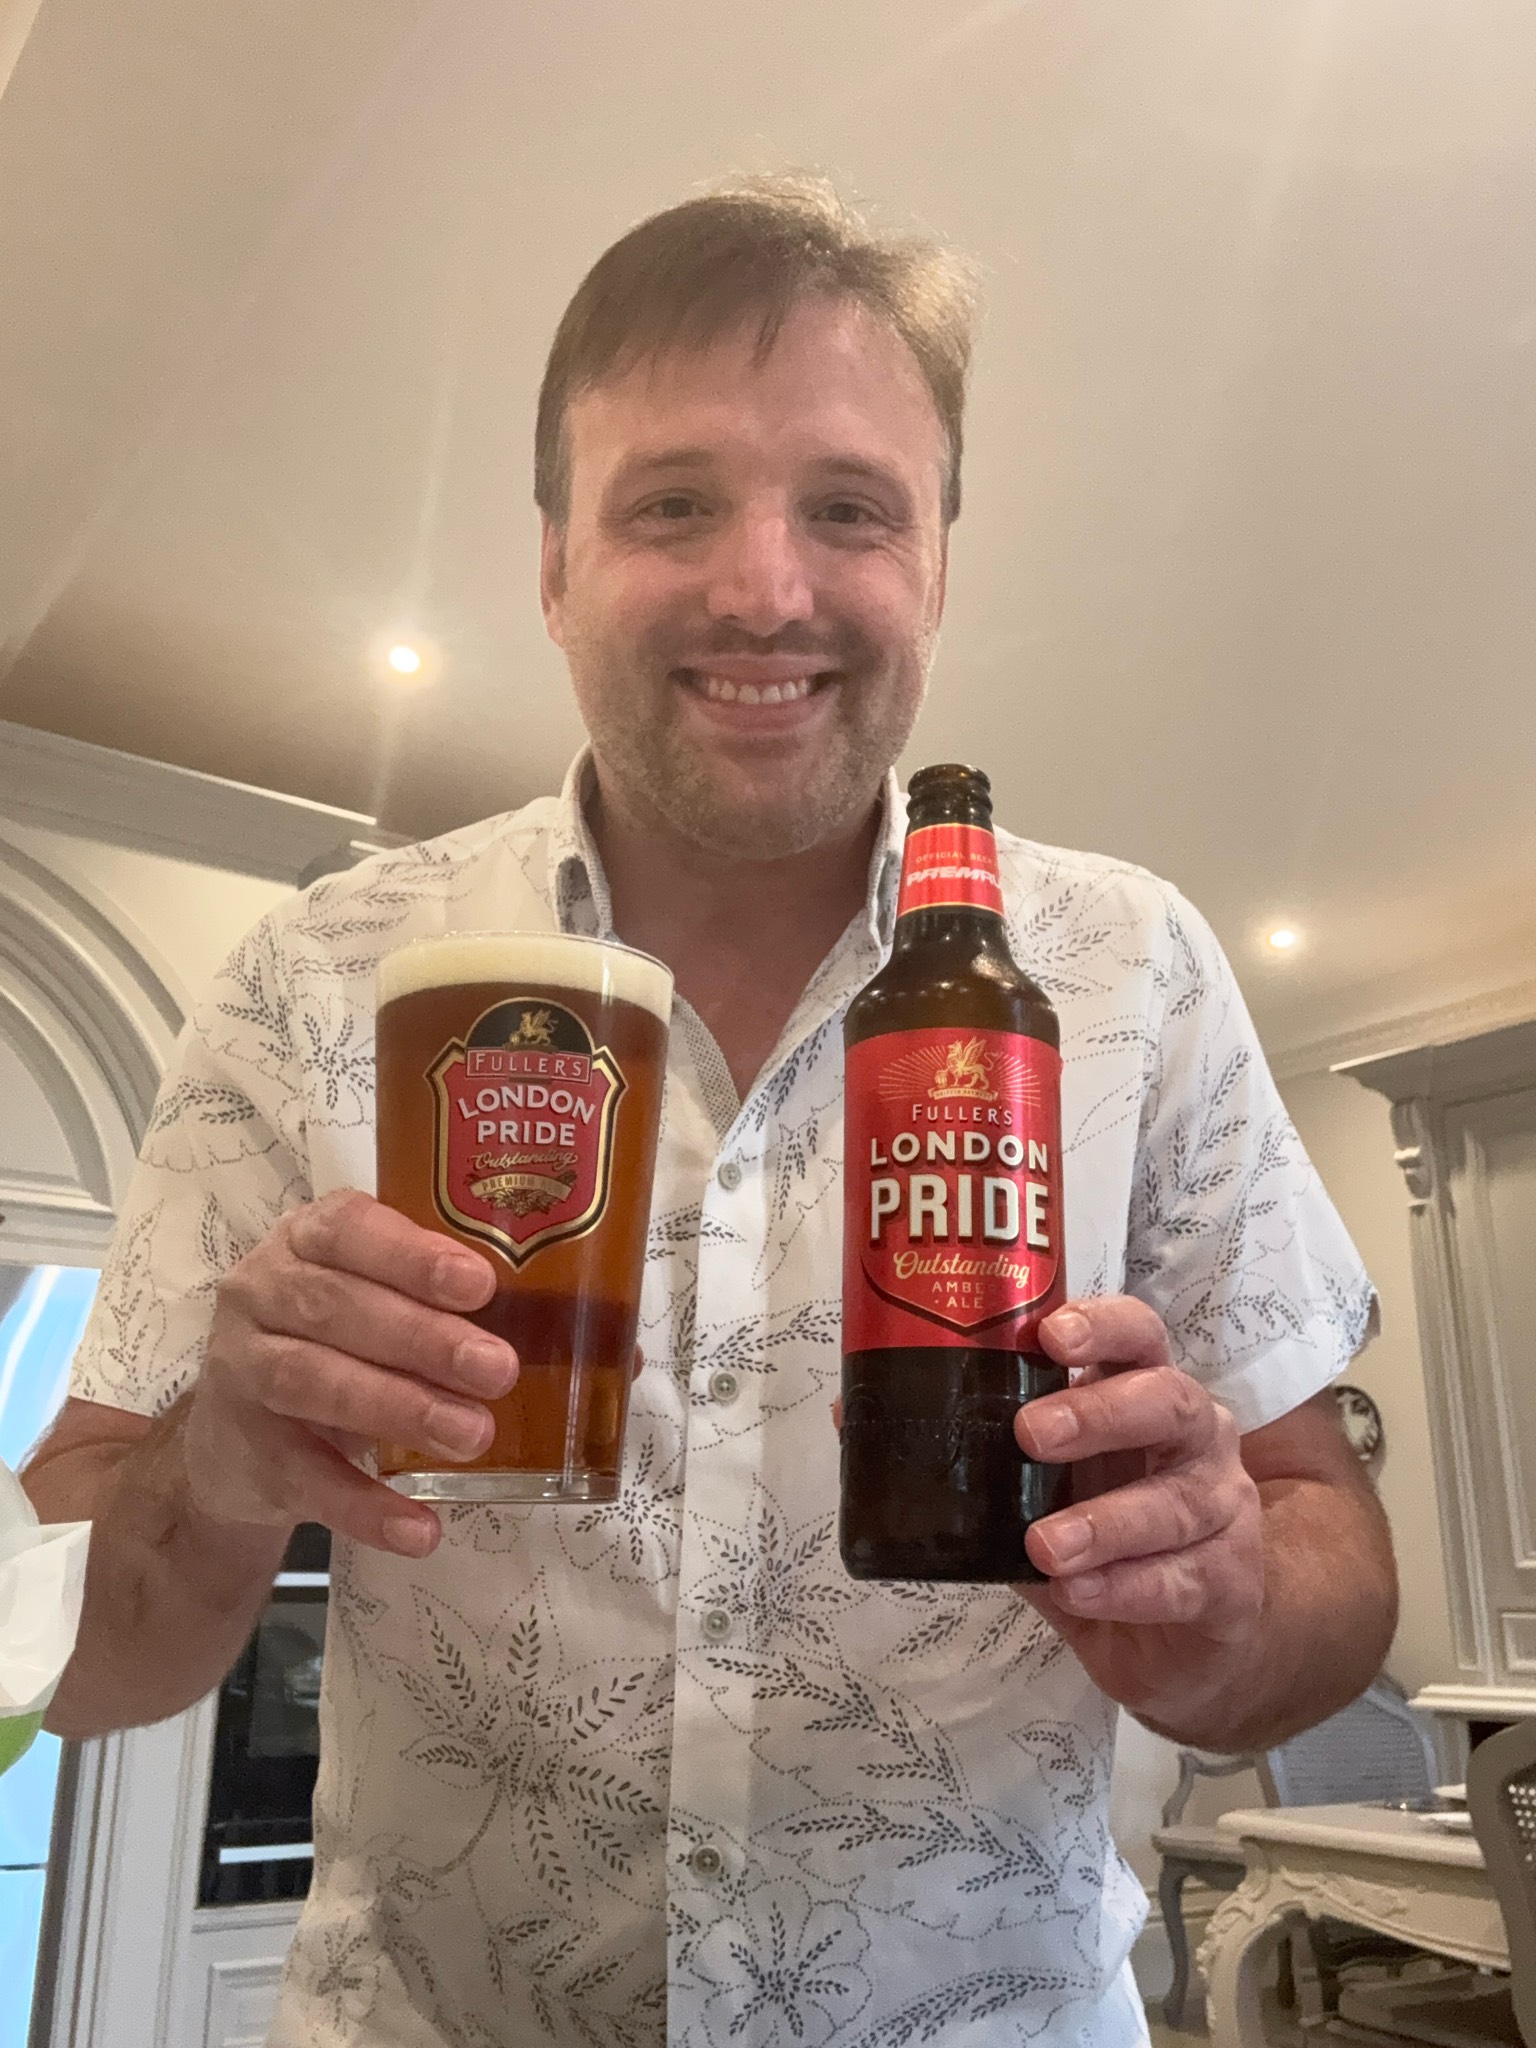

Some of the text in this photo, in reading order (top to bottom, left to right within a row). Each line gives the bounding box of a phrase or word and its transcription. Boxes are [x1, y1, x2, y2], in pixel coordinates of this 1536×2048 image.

[475, 1053, 582, 1077] FULLER'S
[457, 1085, 596, 1125] LONDON
[912, 1104, 1013, 1125] FULLER'S
[477, 1120, 576, 1147] PRIDE
[472, 1150, 579, 1170] Outstanding
[870, 1130, 1048, 1173] LONDON
[870, 1173, 1051, 1248] PRIDE
[893, 1250, 1031, 1288] Outstanding
[932, 1281, 996, 1294] AMBE
[946, 1296, 984, 1309] ALE
